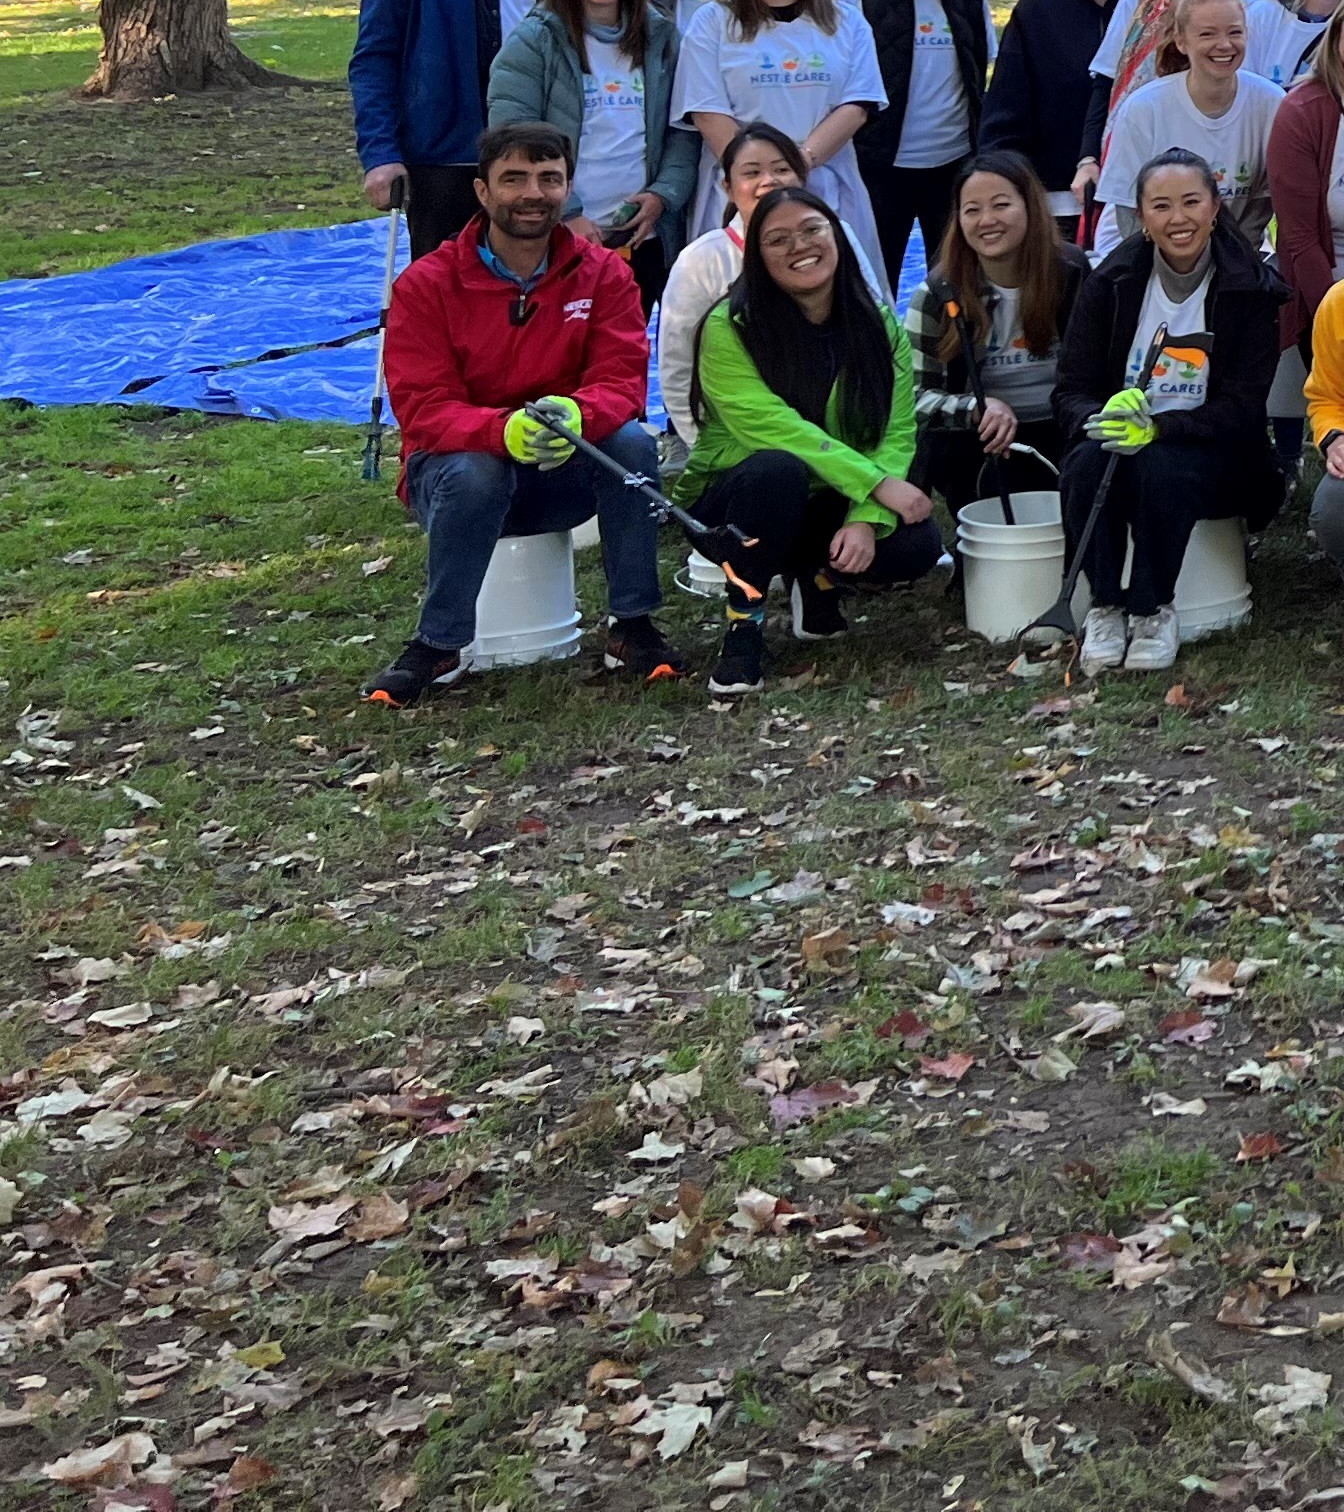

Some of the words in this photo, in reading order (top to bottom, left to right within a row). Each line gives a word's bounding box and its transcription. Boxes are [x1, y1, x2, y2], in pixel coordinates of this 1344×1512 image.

[929, 37, 952, 46] CAR
[794, 72, 832, 83] CARES
[584, 95, 615, 108] ESTLÉ
[1217, 185, 1252, 197] CARE
[1159, 382, 1204, 395] CARES
